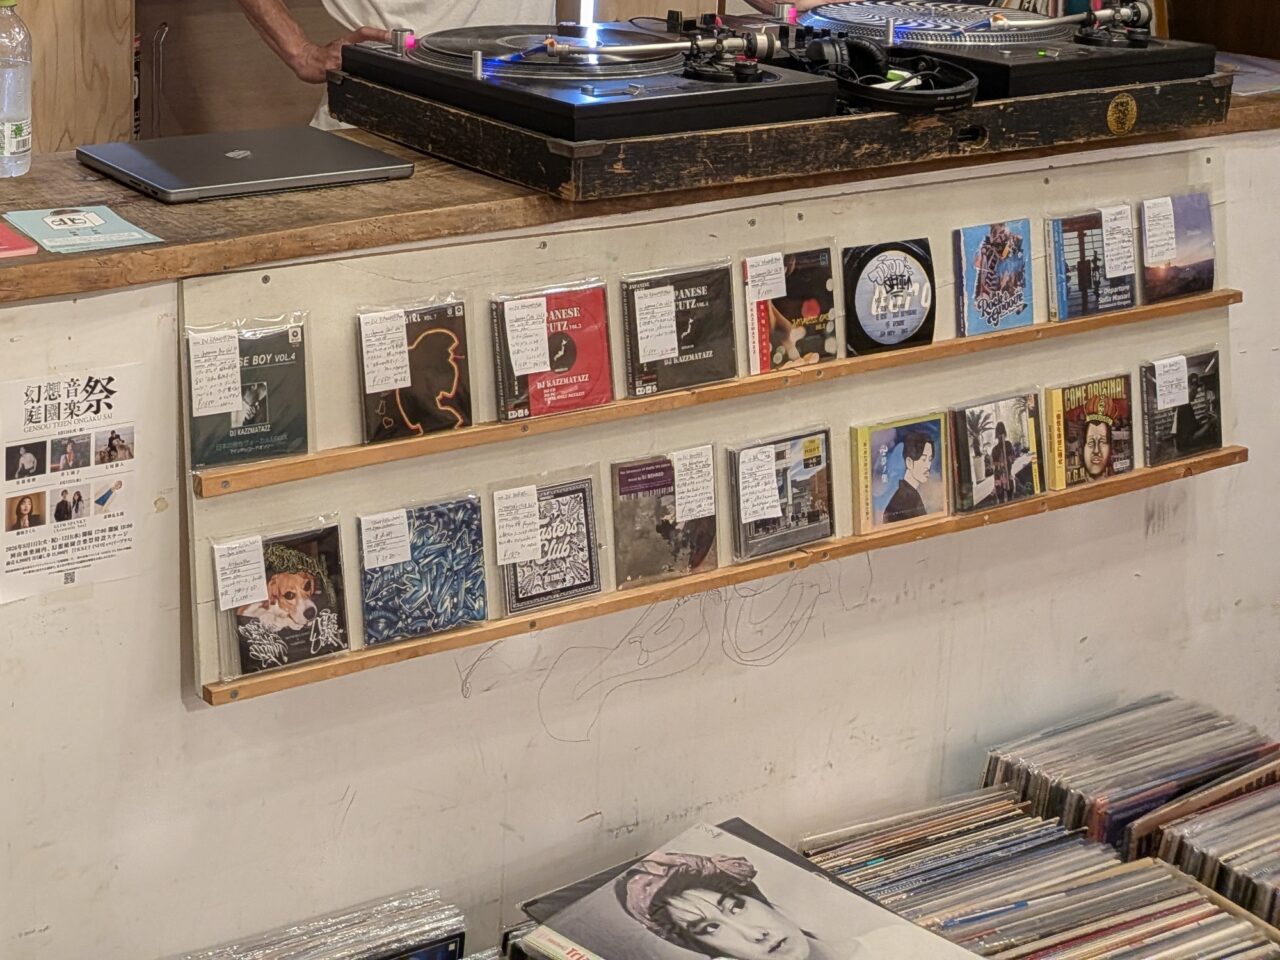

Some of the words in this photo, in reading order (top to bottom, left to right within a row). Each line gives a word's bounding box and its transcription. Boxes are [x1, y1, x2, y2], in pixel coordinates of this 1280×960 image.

[253, 353, 273, 366] BOY
[275, 352, 296, 362] VOL.4
[537, 381, 545, 389] DJ
[546, 374, 589, 388] KAZZMATAZZ
[80, 376, 118, 415] 祭
[1065, 385, 1087, 411] COME
[23, 423, 51, 433] GENSOU
[230, 429, 237, 437] DJ
[238, 424, 271, 436] KAZZMATAZZ
